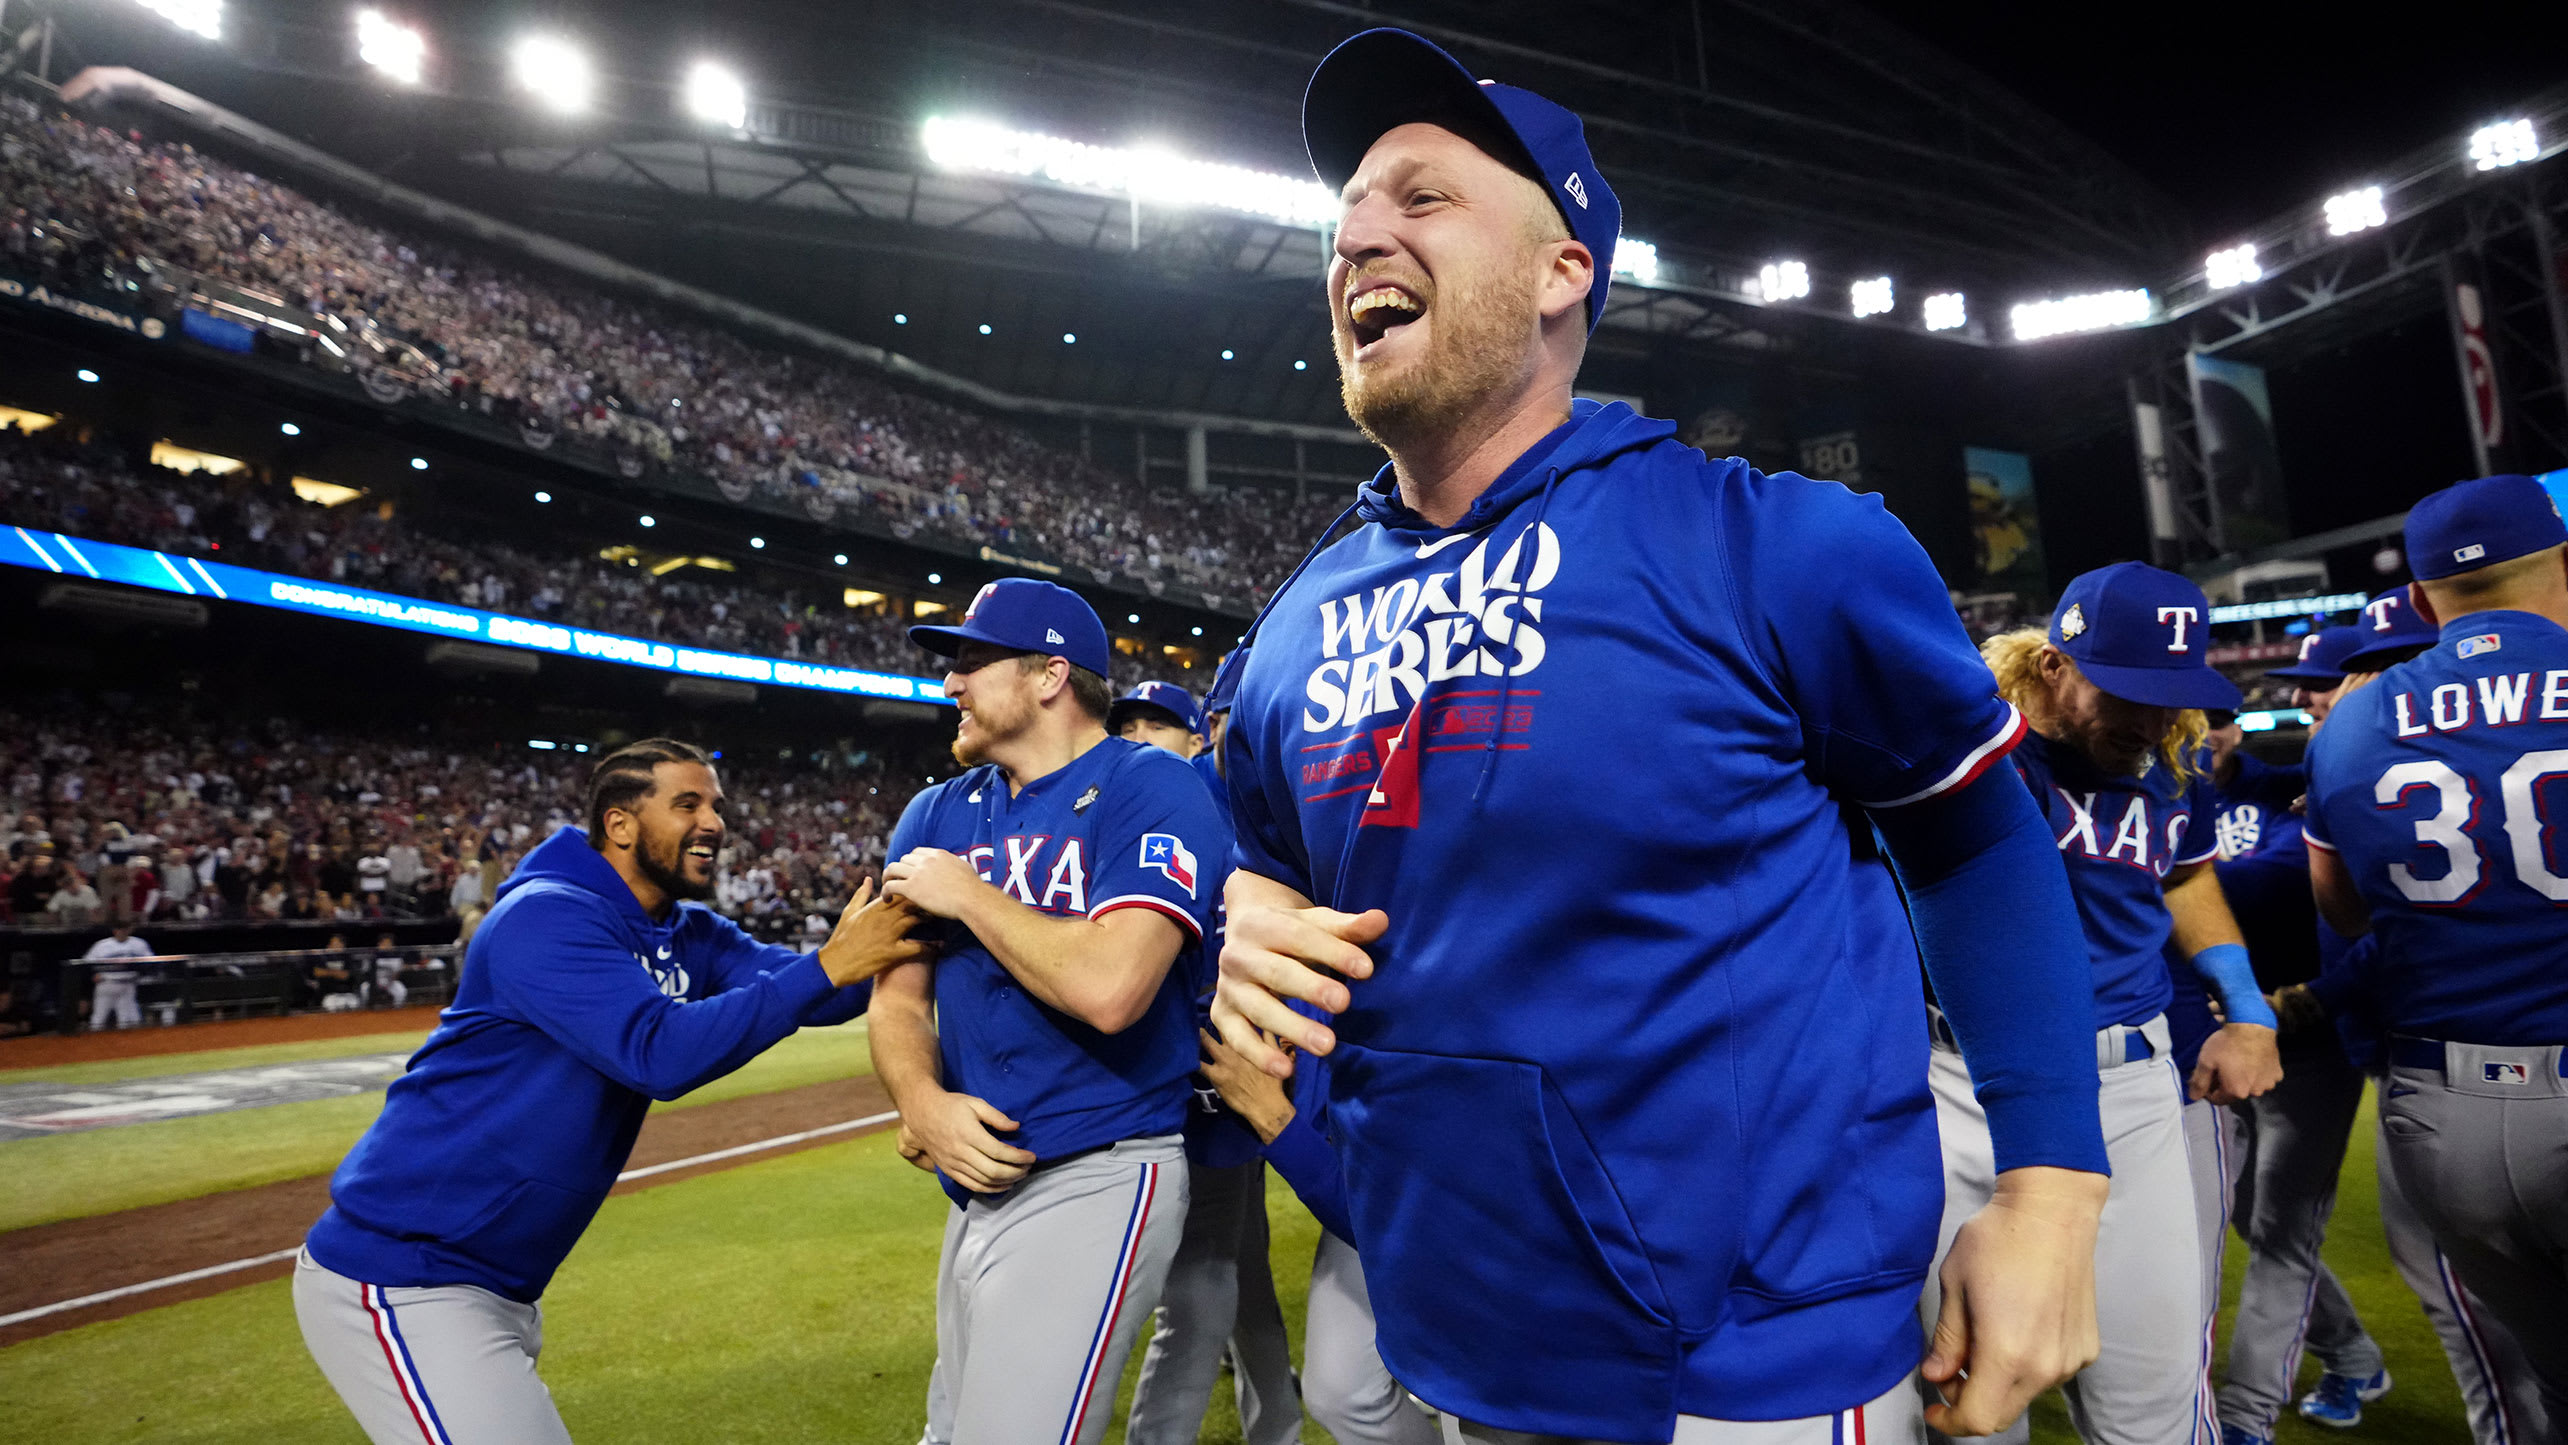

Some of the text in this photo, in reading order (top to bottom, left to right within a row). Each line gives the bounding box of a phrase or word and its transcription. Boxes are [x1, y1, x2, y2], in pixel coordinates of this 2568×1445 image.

[964, 583, 998, 619] T
[2366, 596, 2400, 632] T
[2157, 606, 2199, 654] T
[573, 631, 674, 667] WORLD
[1137, 681, 1162, 699] T
[1302, 751, 1373, 785] RANGERS
[957, 834, 1090, 918] EXA
